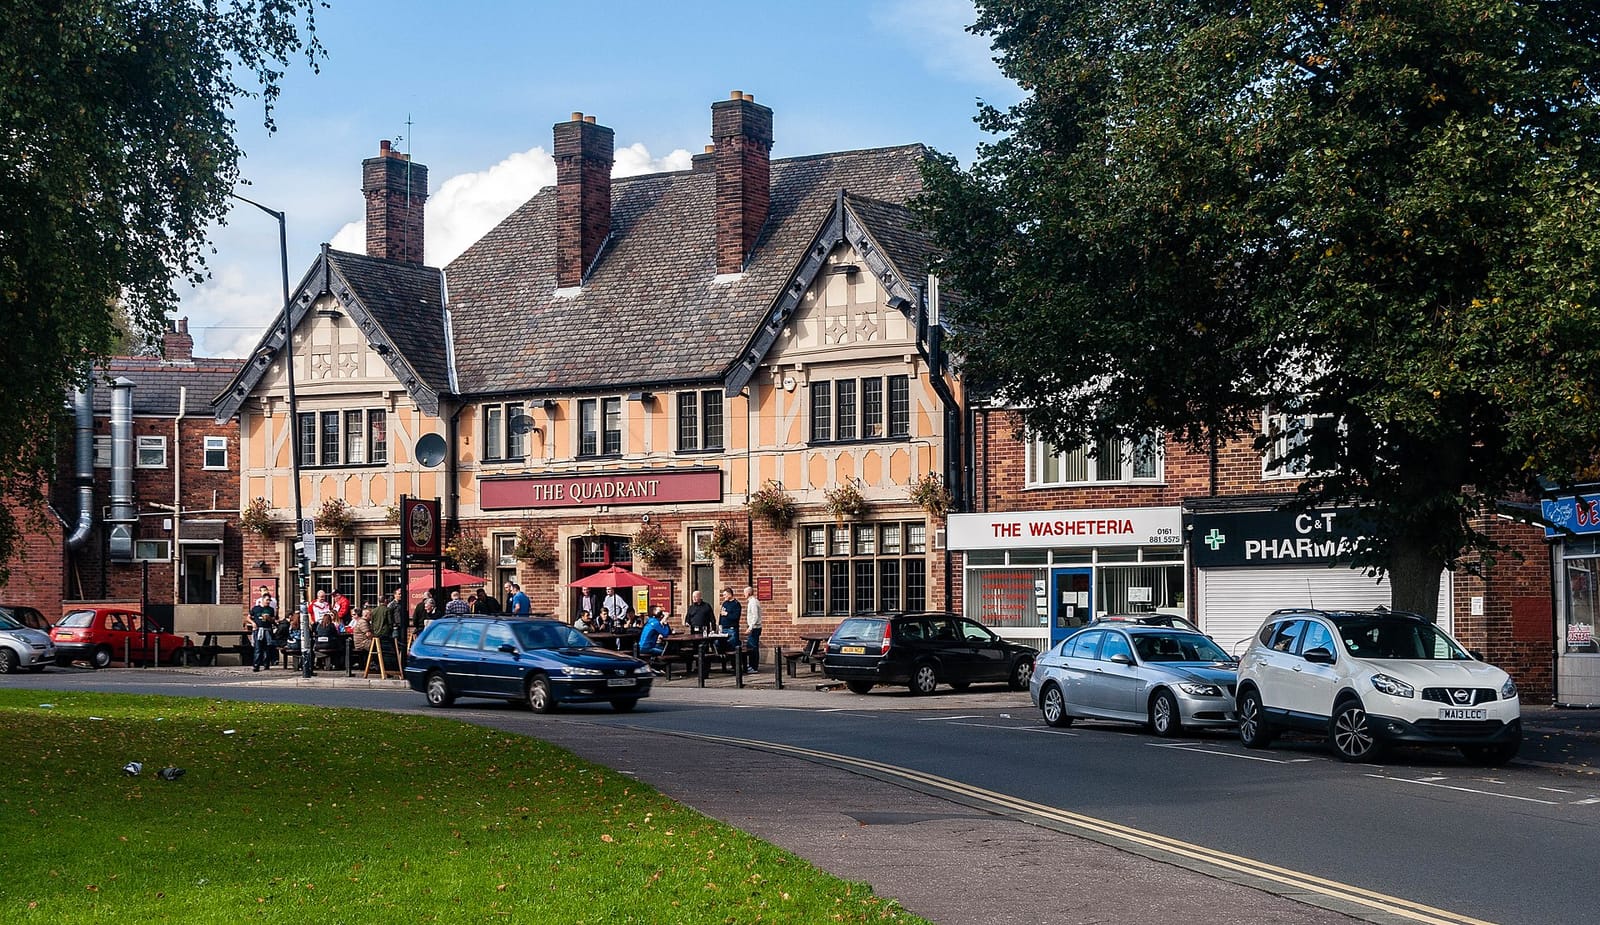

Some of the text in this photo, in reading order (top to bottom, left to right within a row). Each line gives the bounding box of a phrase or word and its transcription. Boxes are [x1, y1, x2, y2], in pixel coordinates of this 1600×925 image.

[533, 480, 660, 503] THE QUADRANT
[1575, 499, 1600, 526] BE
[992, 519, 1134, 537] THE WASHETERIA
[1163, 535, 1180, 543] 5575
[1245, 535, 1386, 560] PHARMA
